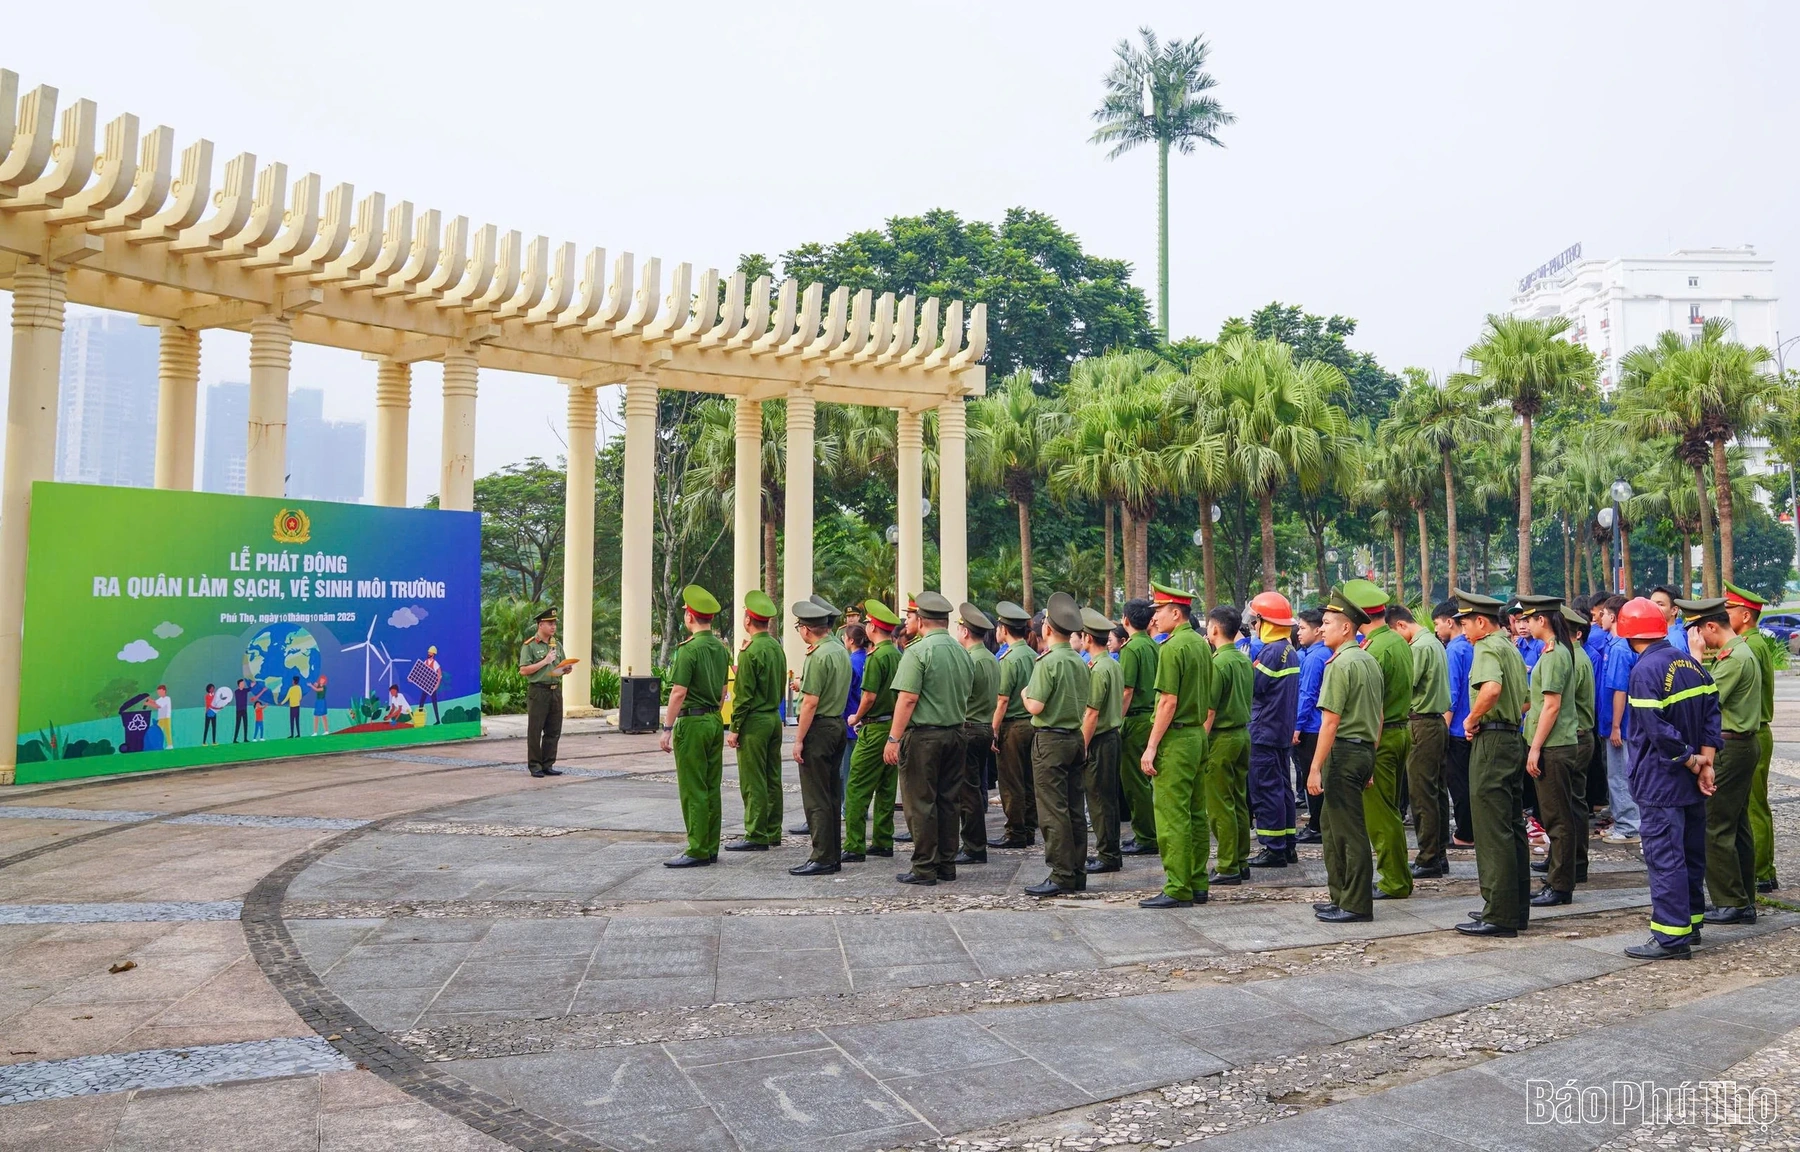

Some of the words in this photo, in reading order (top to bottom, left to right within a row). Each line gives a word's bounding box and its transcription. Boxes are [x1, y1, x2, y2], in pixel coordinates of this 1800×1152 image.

[230, 546, 250, 571] LỄ
[256, 550, 299, 572] PHÁT
[303, 551, 348, 577] ĐỘNG
[93, 576, 121, 597] RA
[127, 573, 182, 599] QUÂN
[188, 574, 228, 597] LÀM
[233, 578, 285, 601] SẠCH,
[290, 576, 310, 601] VỆ
[315, 579, 353, 598] SINH
[357, 577, 386, 598] MÔI
[390, 577, 446, 598] TRƯỜNG
[220, 613, 237, 623] Phú
[239, 613, 257, 624] Thọ,
[337, 612, 356, 621] 2025
